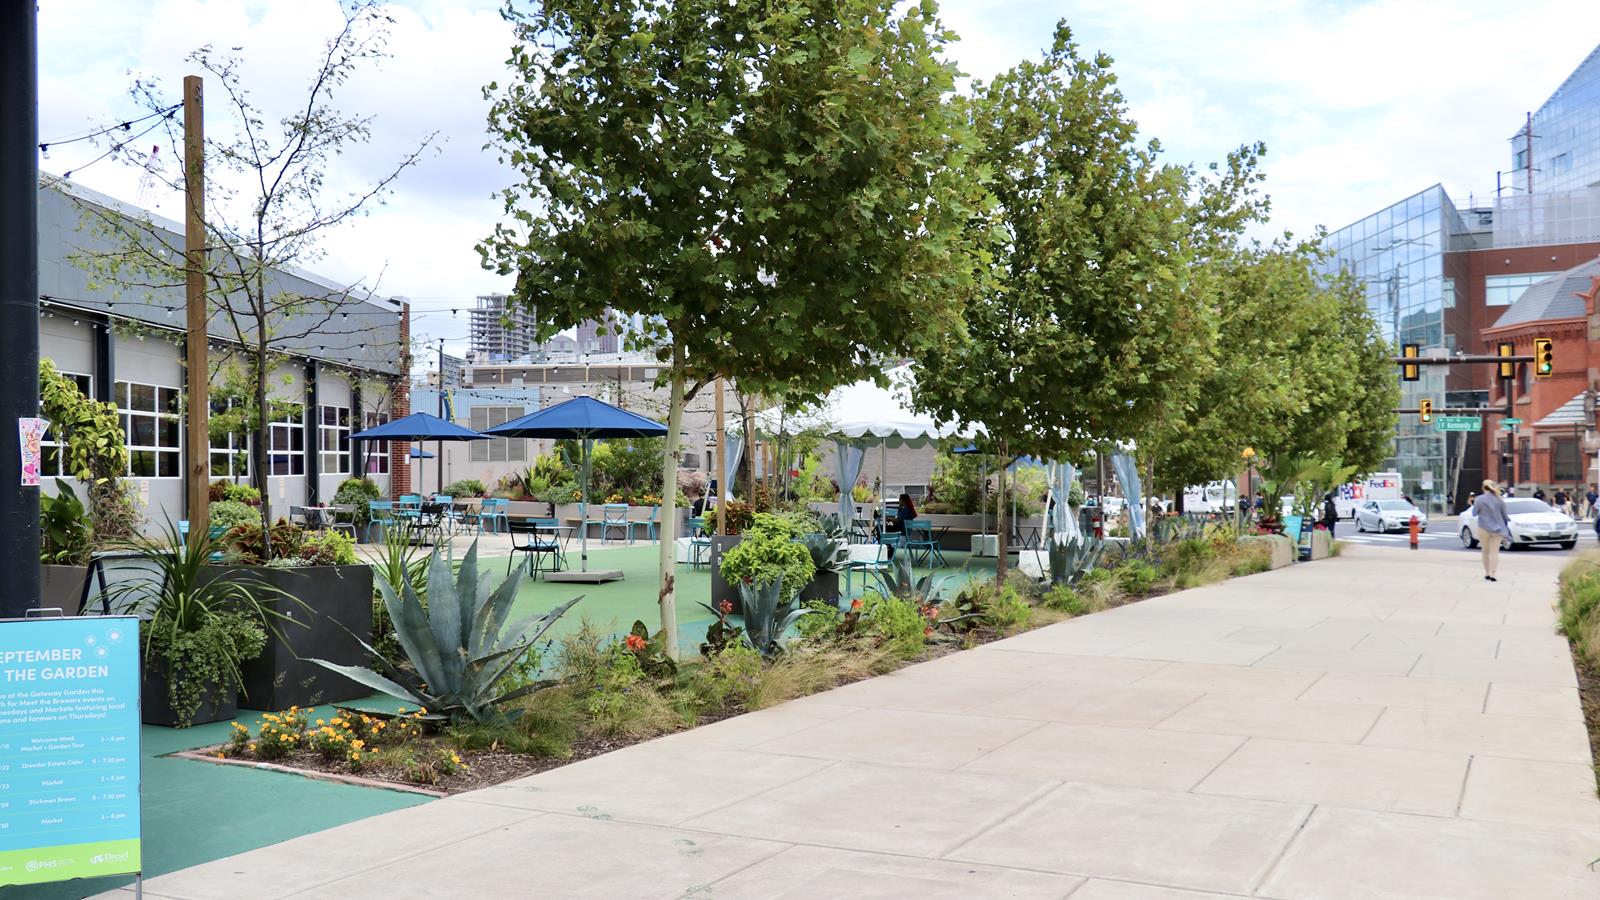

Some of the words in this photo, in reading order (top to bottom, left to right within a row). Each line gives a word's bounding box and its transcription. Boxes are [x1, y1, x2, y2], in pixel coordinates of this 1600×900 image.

[1447, 421, 1471, 430] Kennedy
[1370, 479, 1398, 488] FedEx
[4, 668, 37, 682] THE
[41, 665, 108, 680] GARDEN
[30, 690, 62, 698] Gateway
[63, 688, 90, 696] Garden
[44, 704, 74, 713] Markets
[75, 703, 108, 712] featuring
[108, 702, 126, 710] local
[68, 711, 107, 720] Thursdays!
[20, 744, 43, 752] Market
[40, 816, 64, 824] Market
[39, 859, 57, 869] PHS
